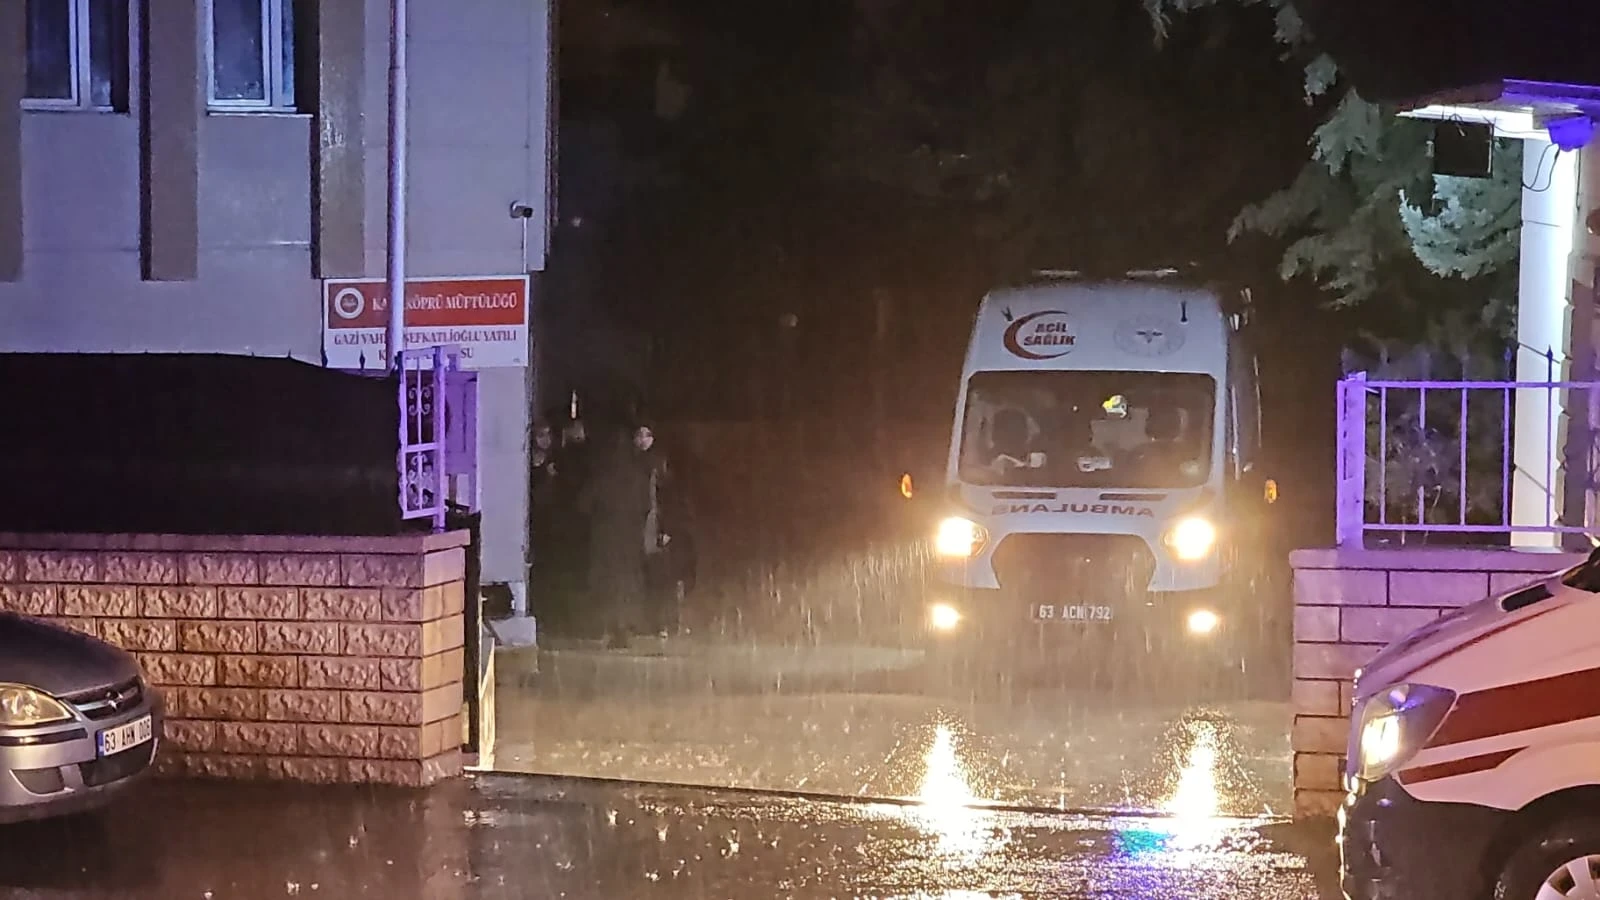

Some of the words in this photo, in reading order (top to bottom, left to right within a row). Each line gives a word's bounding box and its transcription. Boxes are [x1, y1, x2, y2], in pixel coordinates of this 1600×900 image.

[372, 294, 444, 311] KAKÖPRÜ
[334, 331, 359, 345] GAZİ
[1024, 334, 1076, 347] SAĞLIK
[1039, 604, 1054, 619] 63
[1088, 605, 1110, 620] 792
[105, 731, 116, 752] 63
